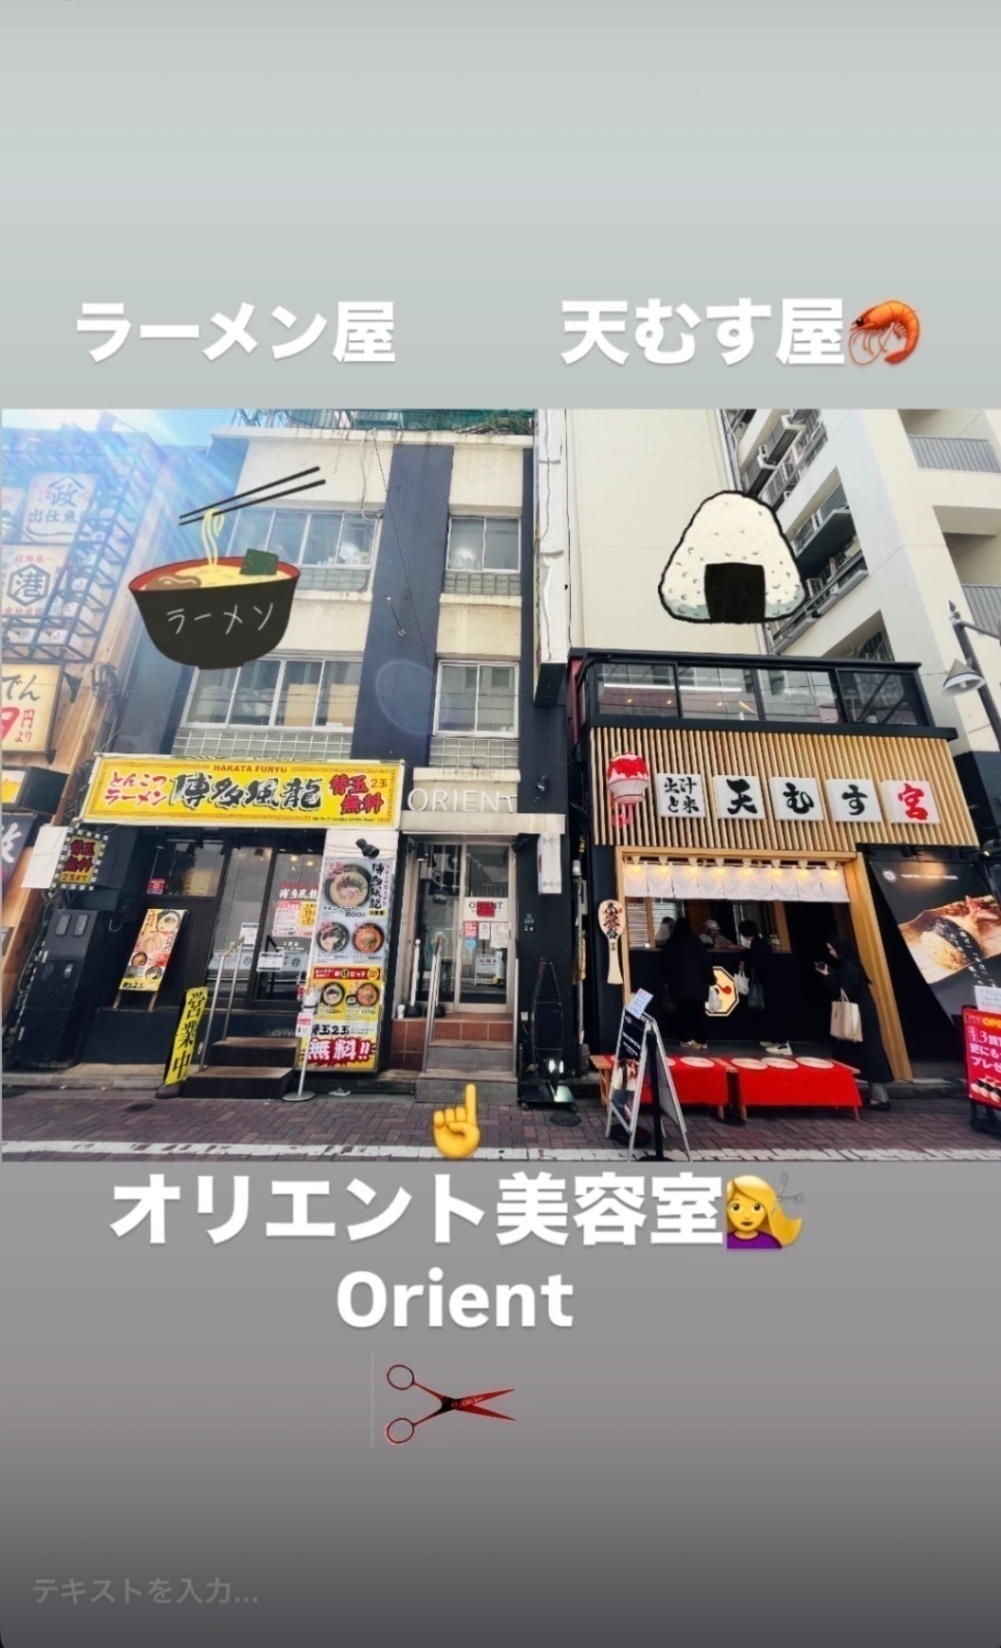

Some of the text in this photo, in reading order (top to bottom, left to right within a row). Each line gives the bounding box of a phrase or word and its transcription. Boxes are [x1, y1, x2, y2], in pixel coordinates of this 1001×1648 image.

[111, 771, 167, 787] とんこつ
[213, 764, 288, 773] HAKATA FURYU
[168, 771, 324, 812] 博多風龍
[329, 773, 370, 796] 替玉
[104, 788, 168, 807] ラーメン
[340, 792, 384, 815] 無料
[407, 787, 518, 813] ORIENT
[667, 795, 700, 814] と米
[725, 778, 930, 822] 天むす宮
[172, 992, 206, 1080] 営業中
